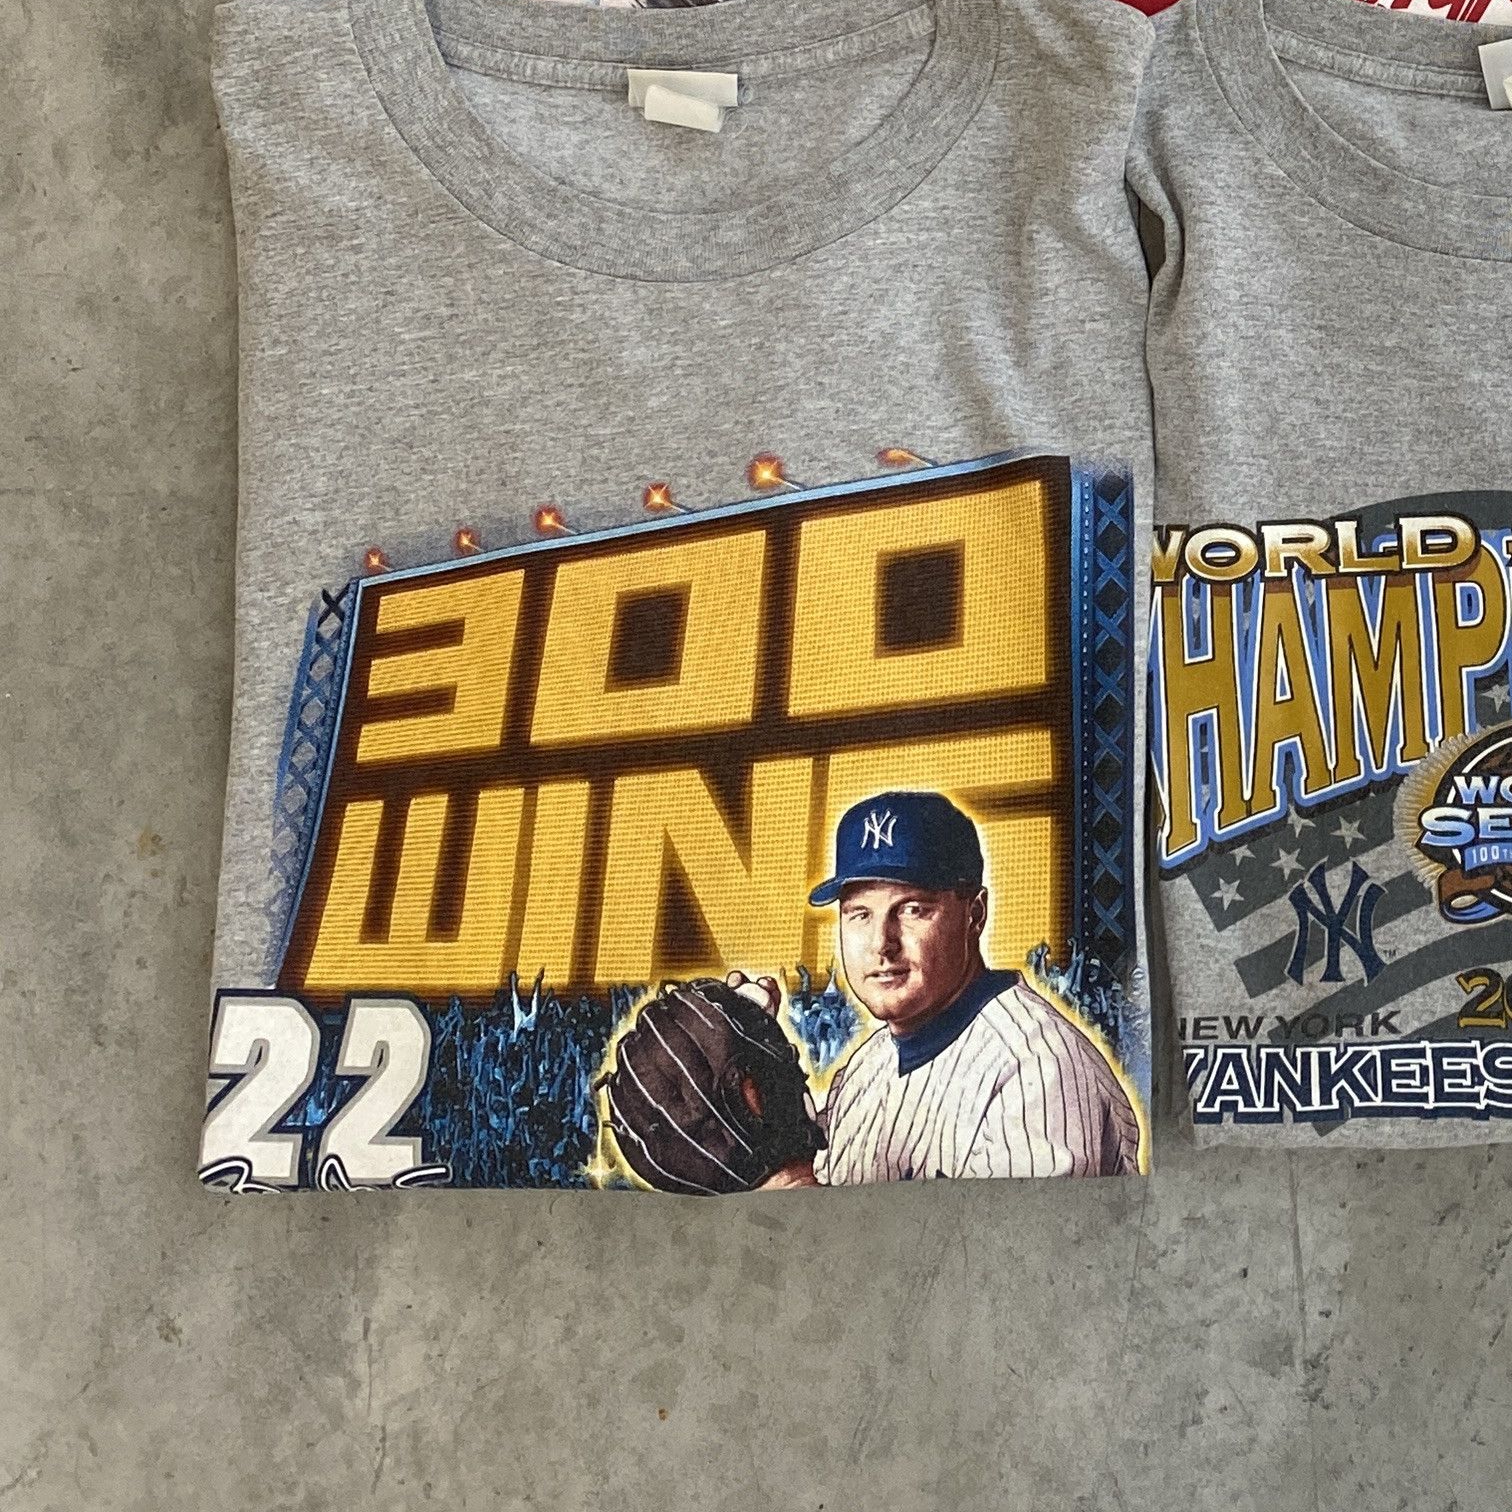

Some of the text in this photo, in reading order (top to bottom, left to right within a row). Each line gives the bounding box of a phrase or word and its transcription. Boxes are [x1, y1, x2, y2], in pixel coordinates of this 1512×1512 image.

[356, 479, 1050, 764] 300
[200, 989, 432, 1188] 22
[1275, 1010, 1401, 1037] YORK
